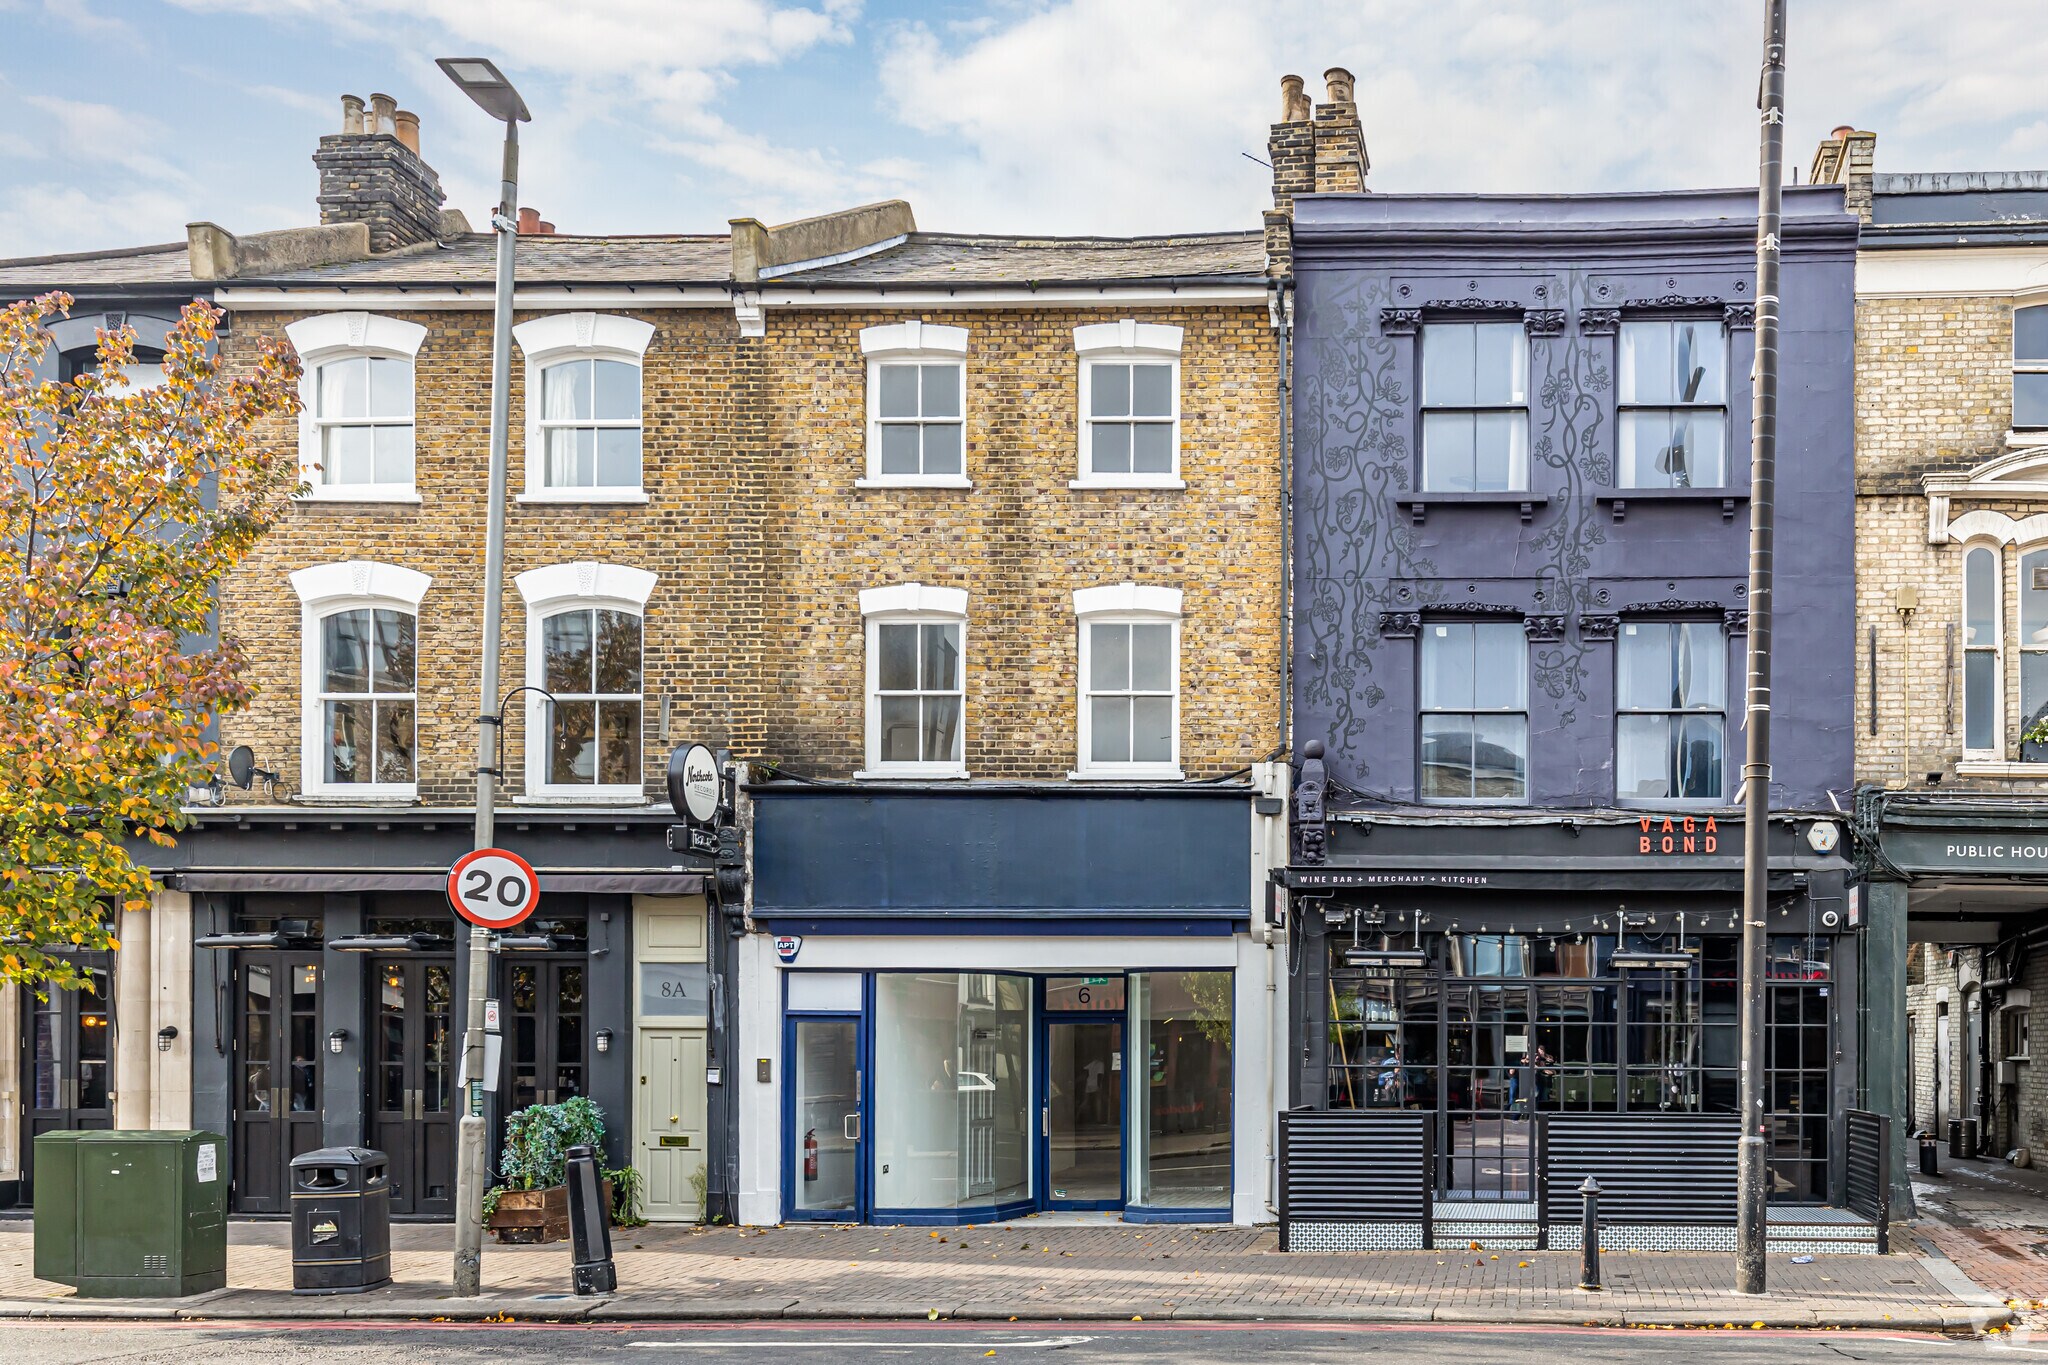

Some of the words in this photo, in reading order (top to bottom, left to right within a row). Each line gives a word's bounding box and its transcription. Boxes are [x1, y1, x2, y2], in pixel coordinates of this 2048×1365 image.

[685, 765, 714, 787] Northcote
[694, 783, 715, 796] RECORDS
[1639, 816, 1718, 833] VAGA
[1639, 836, 1718, 854] BOND
[1947, 845, 2004, 857] PUBLIC
[2011, 846, 2048, 858] HOU
[1368, 875, 1425, 883] MERCHANT
[1441, 876, 1487, 884] KITCHEN
[463, 869, 526, 907] 20
[661, 981, 687, 997] 8A
[1078, 987, 1091, 1003] 6
